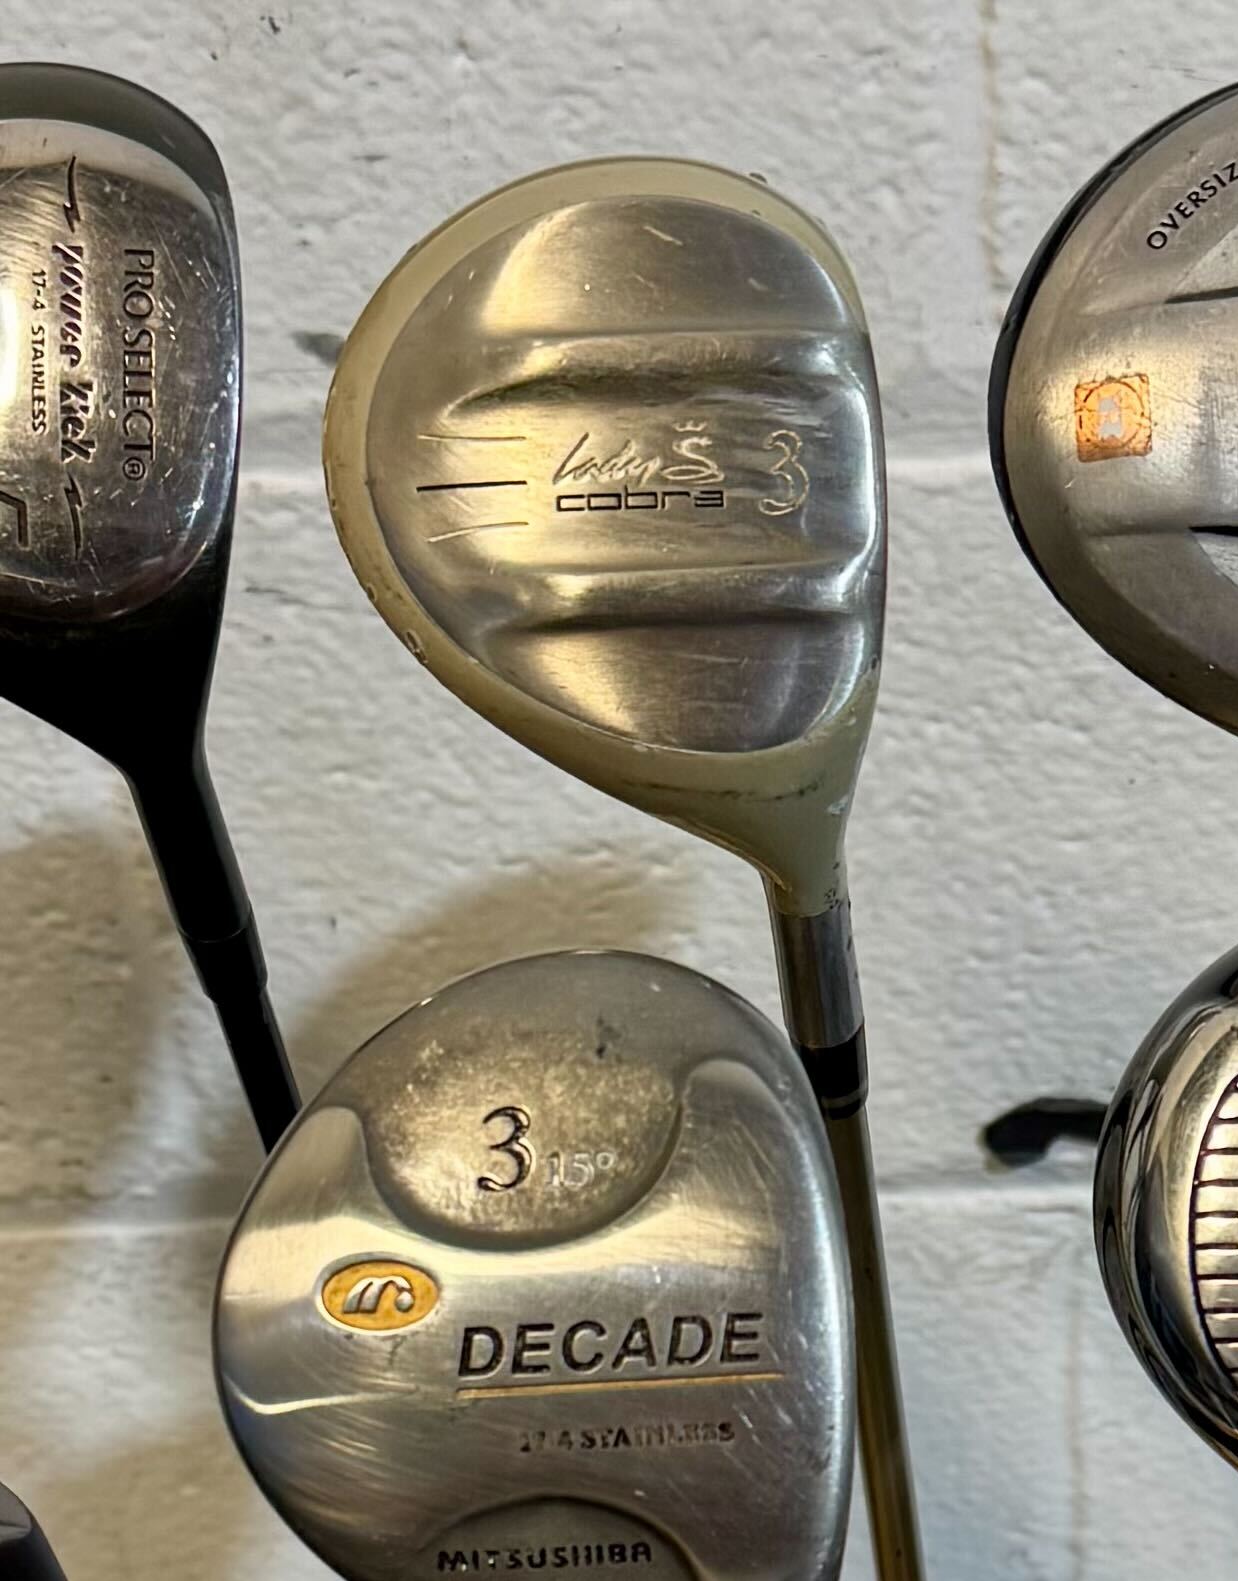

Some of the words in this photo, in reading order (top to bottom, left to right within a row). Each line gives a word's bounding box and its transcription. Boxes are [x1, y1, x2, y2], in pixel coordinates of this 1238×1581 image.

[31, 269, 47, 310] 17-4
[122, 249, 154, 319] PRO
[31, 325, 47, 435] STAINLESS
[556, 484, 724, 513] cobra
[760, 429, 810, 516] 3
[477, 1105, 536, 1193] 3
[457, 1311, 763, 1379] DECADE
[437, 1542, 652, 1572] MITSUSHIBA
